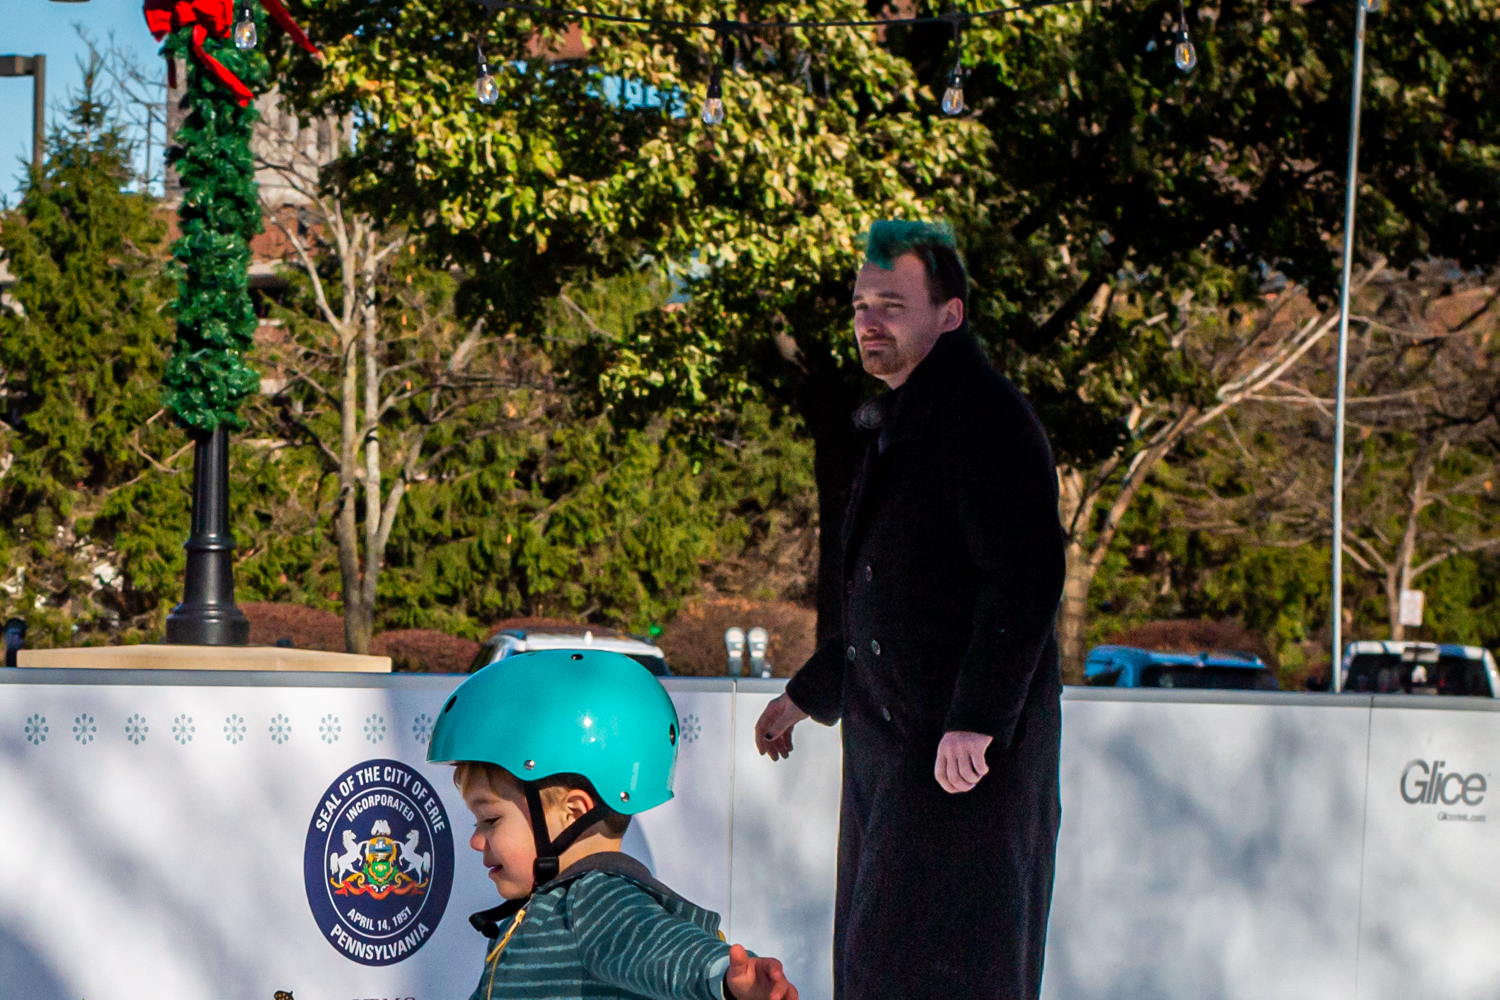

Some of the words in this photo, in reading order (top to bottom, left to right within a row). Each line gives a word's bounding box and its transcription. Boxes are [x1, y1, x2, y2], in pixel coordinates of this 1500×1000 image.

[315, 793, 342, 832] SEAL
[339, 775, 355, 797] OF
[355, 765, 381, 786] THE
[383, 766, 412, 788] CITY
[411, 781, 428, 800] OF
[424, 797, 446, 834] ERIE
[1400, 758, 1487, 806] Glice
[345, 794, 415, 823] INCORPORATED
[347, 908, 375, 931] APRIL
[377, 919, 391, 931] 14,
[392, 906, 412, 927] 1851
[330, 922, 429, 960] PENNSYLVANIA
